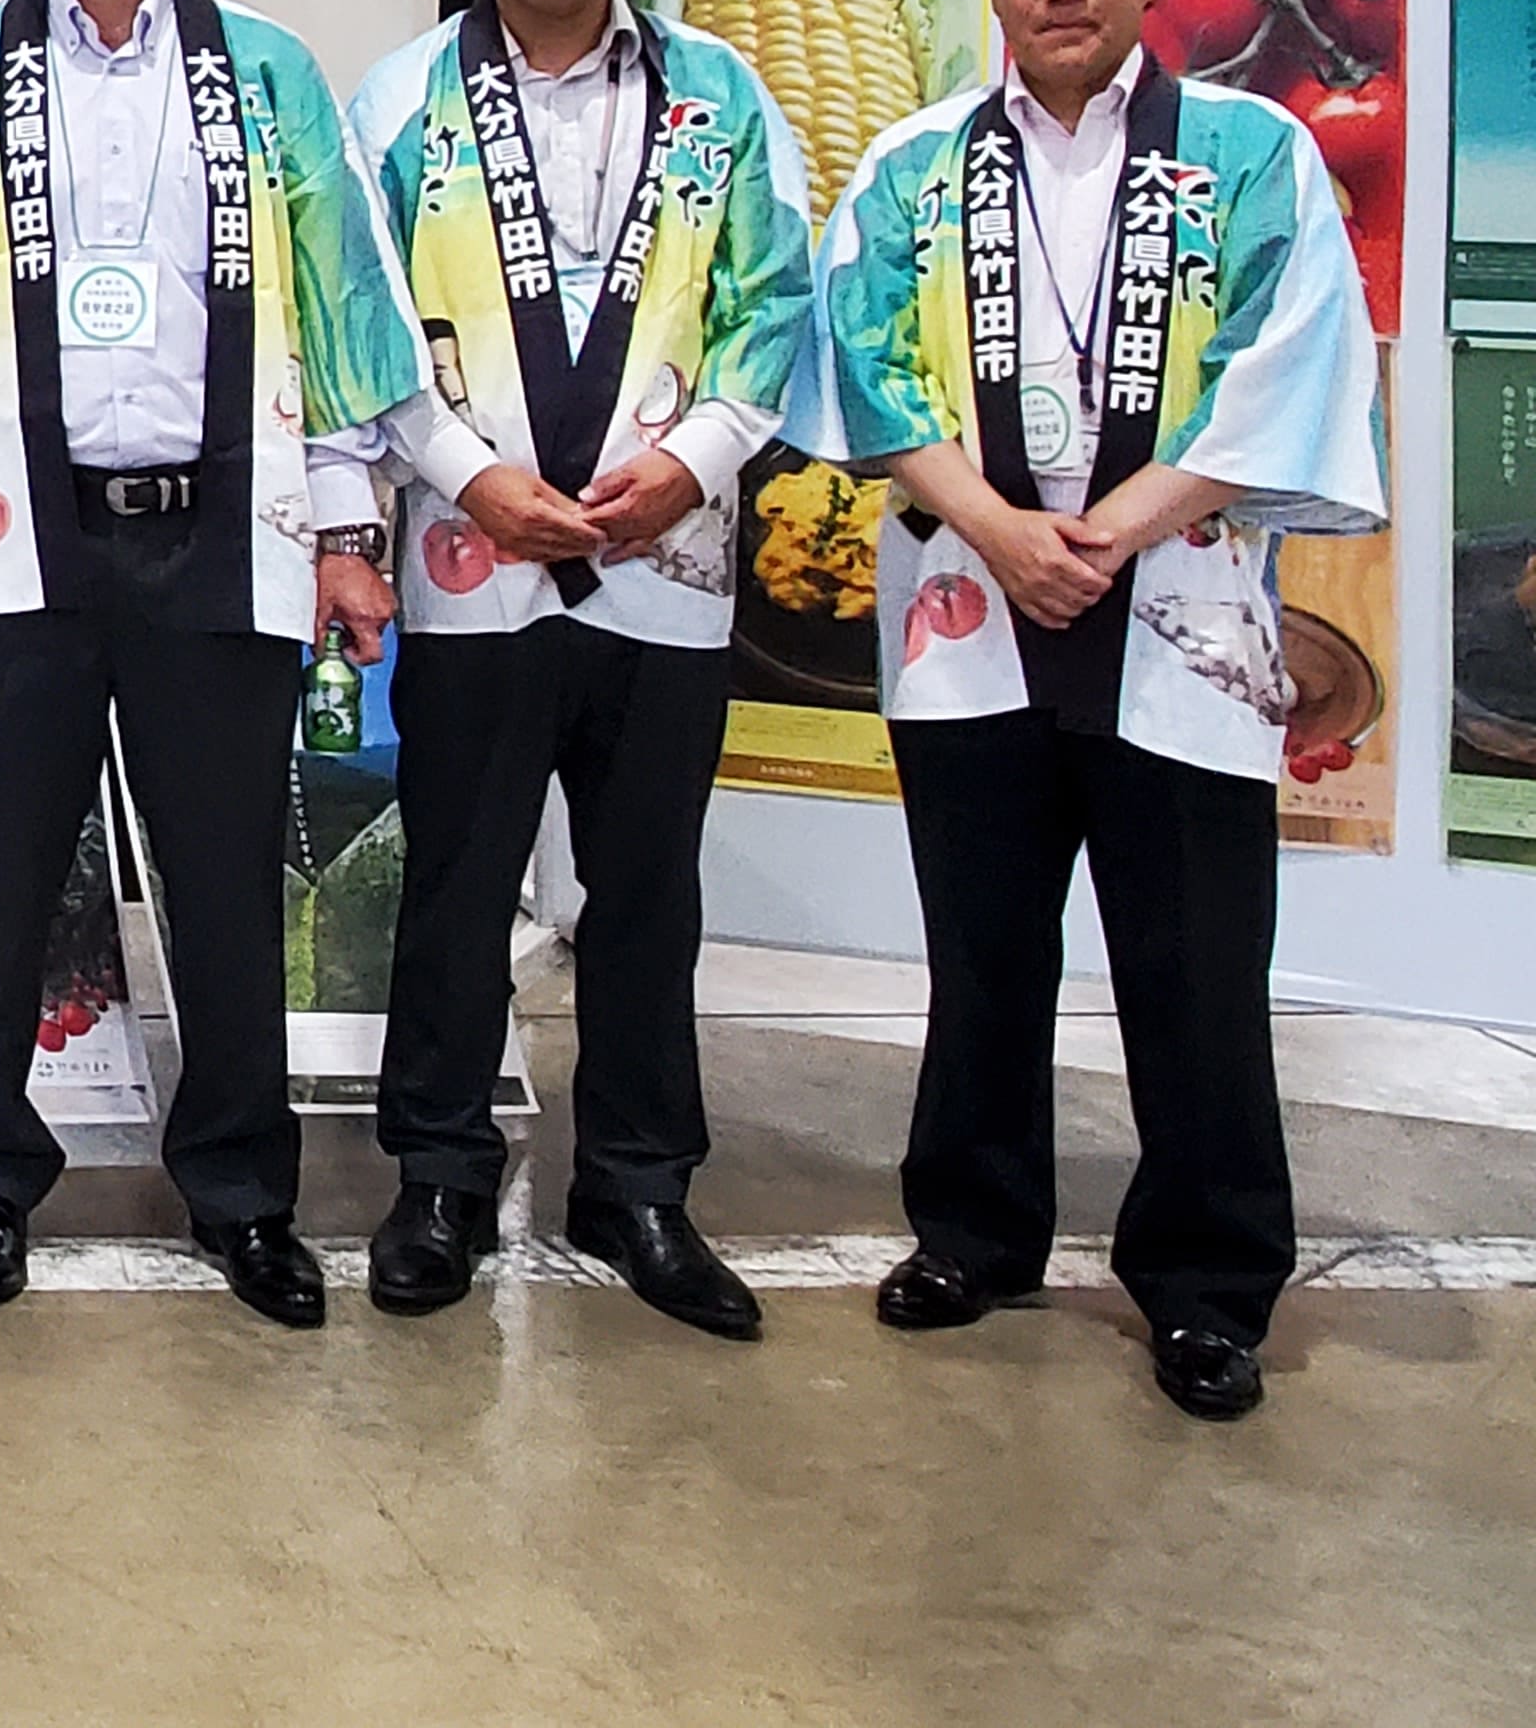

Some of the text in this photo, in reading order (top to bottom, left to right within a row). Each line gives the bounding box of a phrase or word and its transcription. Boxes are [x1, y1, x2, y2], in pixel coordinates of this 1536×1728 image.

[4, 40, 52, 282] 大分県竹田市
[186, 47, 251, 291] 大分県竹田市
[467, 61, 553, 300] 大分県竹田市
[967, 130, 1017, 384] 大分県竹田市
[1108, 149, 1179, 416] 大分県竹田市
